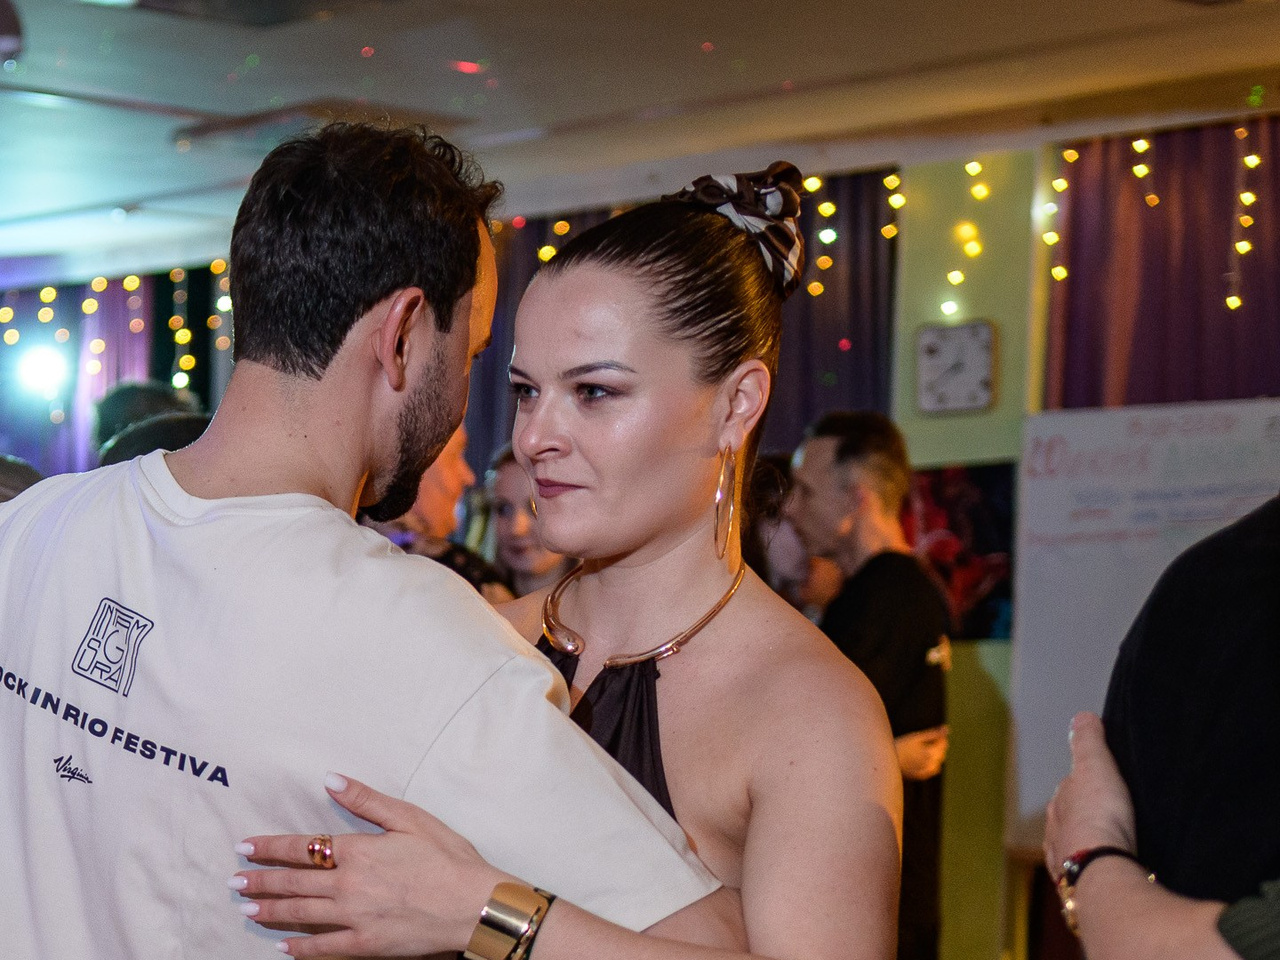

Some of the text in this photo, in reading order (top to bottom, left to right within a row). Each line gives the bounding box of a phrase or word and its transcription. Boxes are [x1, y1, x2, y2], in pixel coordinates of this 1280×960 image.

[29, 686, 61, 715] IN
[62, 702, 109, 738] RIO
[110, 726, 230, 788] FESTIVA
